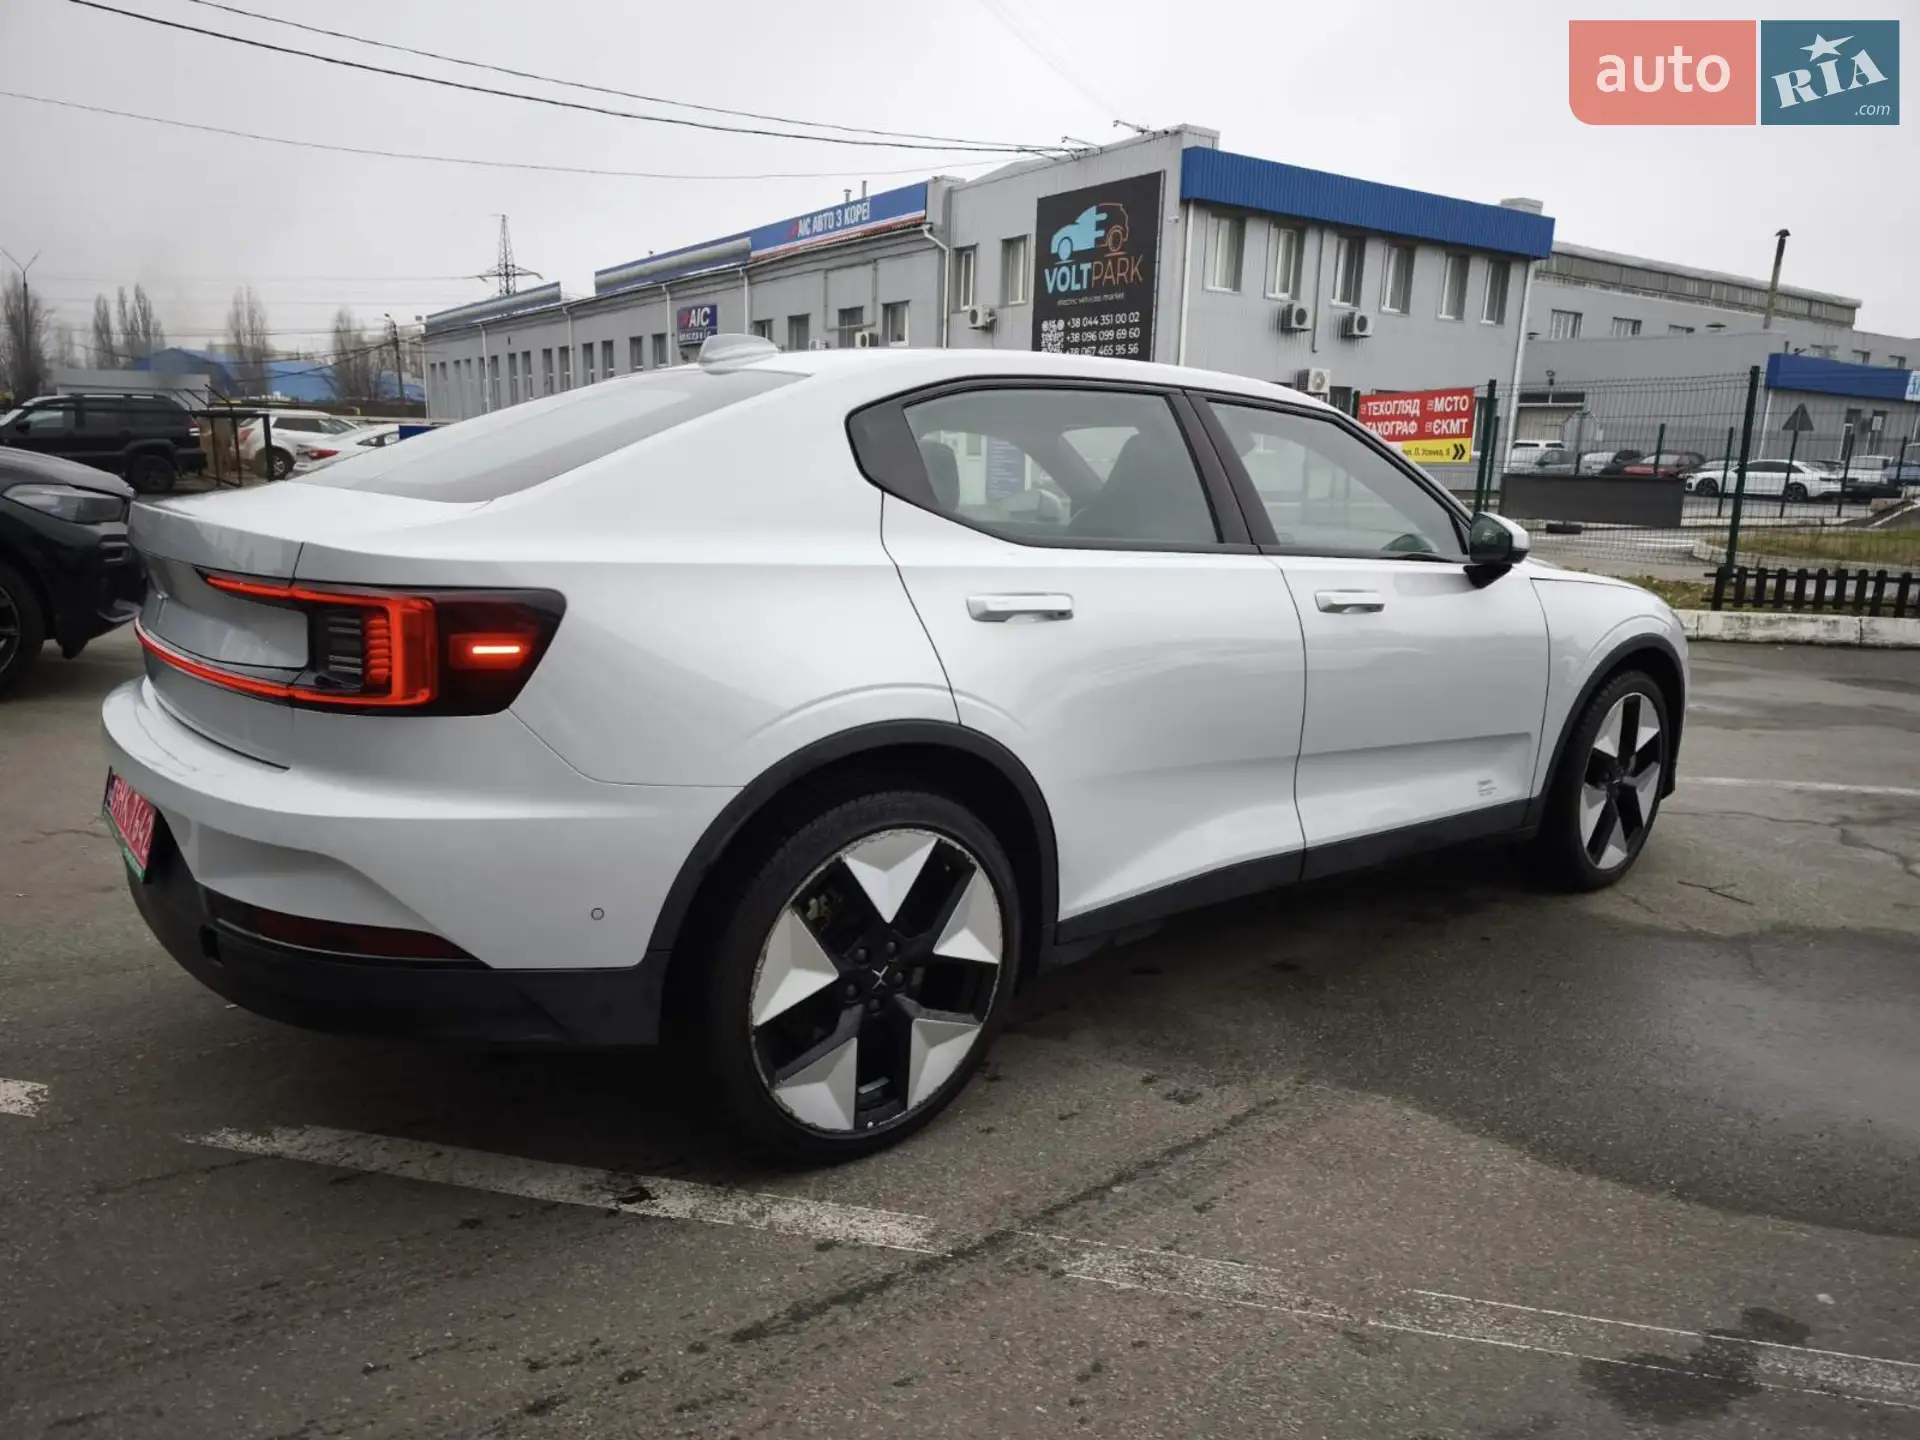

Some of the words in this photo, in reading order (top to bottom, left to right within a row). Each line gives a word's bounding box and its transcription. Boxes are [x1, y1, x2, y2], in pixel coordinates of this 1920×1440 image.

[812, 211, 834, 233] АВТО
[1044, 253, 1144, 295] VOLTPARK
[1067, 318, 1080, 328] +38
[1082, 316, 1098, 328] 044
[1100, 313, 1113, 325] 351
[1115, 312, 1127, 324] 00
[1129, 311, 1140, 322] 02
[1066, 332, 1080, 343] +38
[1082, 331, 1097, 342] 096
[1128, 343, 1139, 354] 56
[1367, 398, 1420, 417] ТЕХОГЛЯД
[1434, 395, 1469, 413] МСТО
[1433, 418, 1469, 435] ЄКМТ
